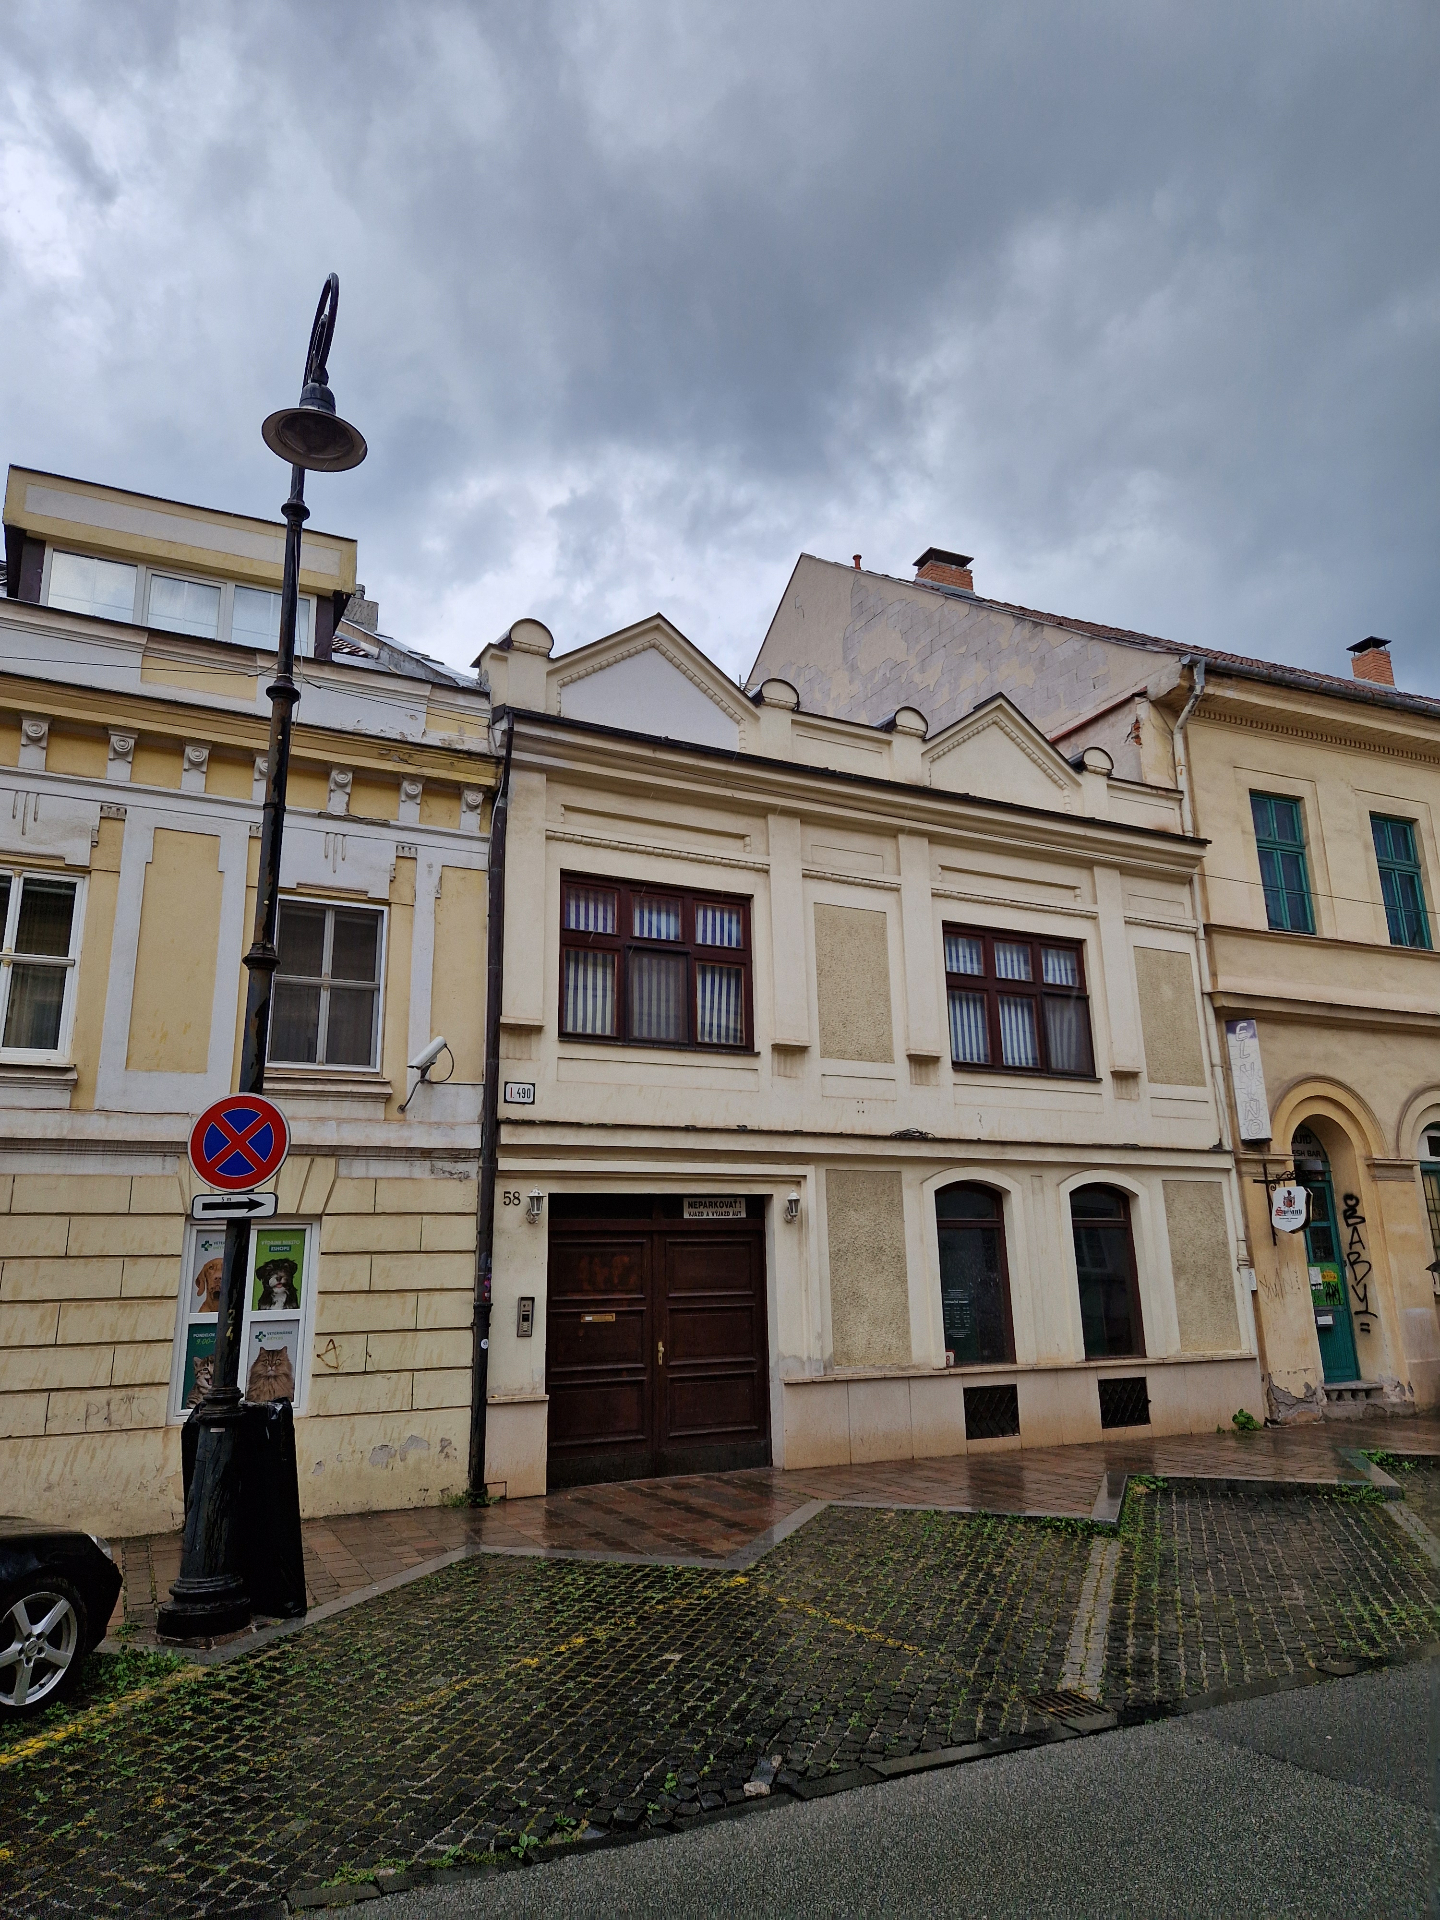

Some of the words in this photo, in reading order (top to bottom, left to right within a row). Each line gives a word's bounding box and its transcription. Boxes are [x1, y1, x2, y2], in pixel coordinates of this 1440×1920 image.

[516, 1087, 531, 1099] 490
[1306, 1150, 1322, 1158] BAR
[503, 1191, 521, 1206] 58
